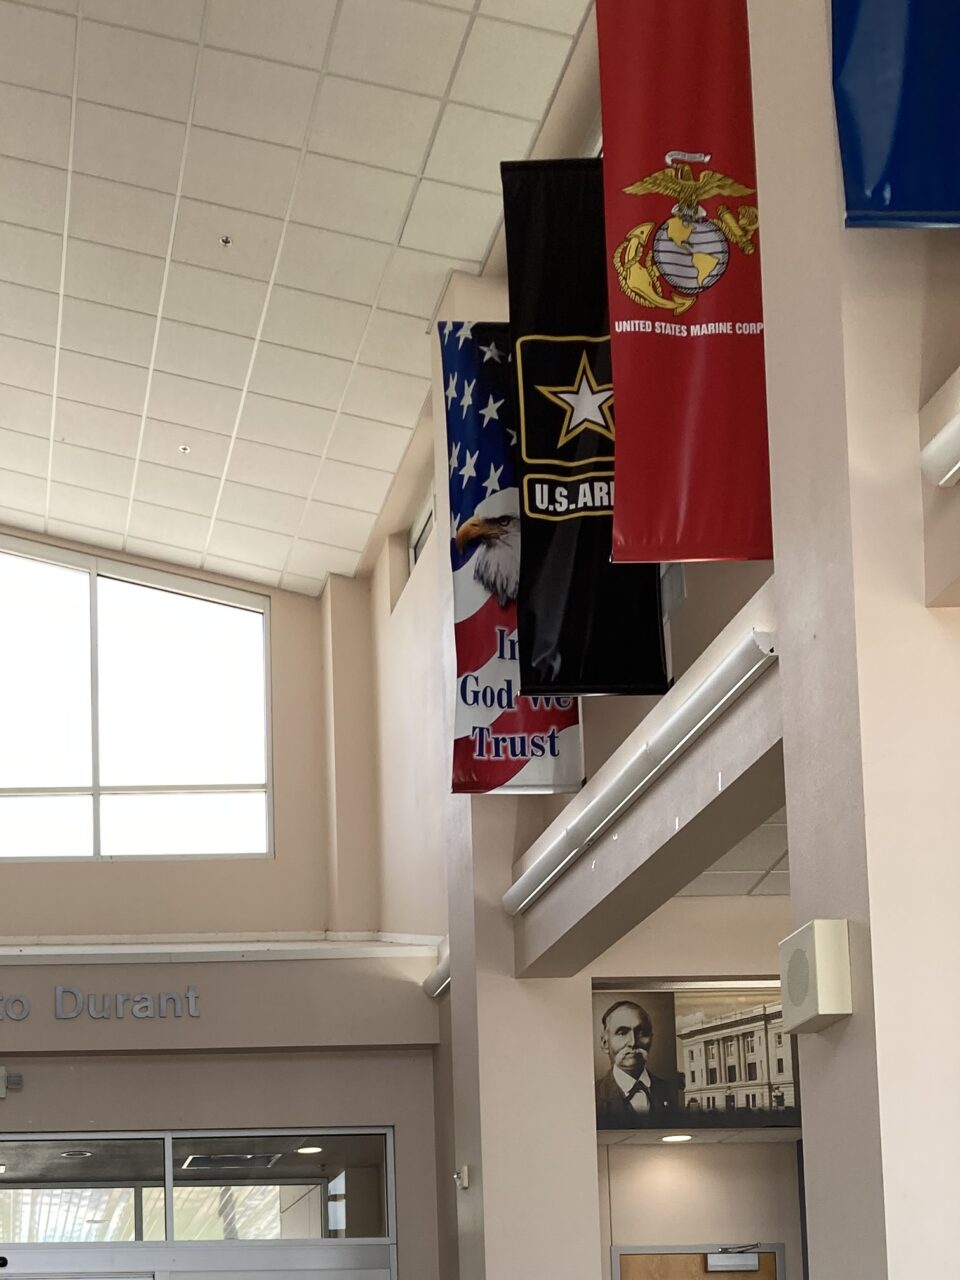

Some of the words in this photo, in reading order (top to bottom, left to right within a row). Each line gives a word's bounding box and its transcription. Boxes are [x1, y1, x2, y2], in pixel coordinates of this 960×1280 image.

[615, 320, 652, 332] UNITED
[655, 321, 687, 336] STATES
[690, 323, 733, 336] MARINE
[577, 481, 615, 507] AR
[460, 674, 514, 709] God
[472, 726, 560, 758] Trust
[54, 984, 200, 1020] Durant
